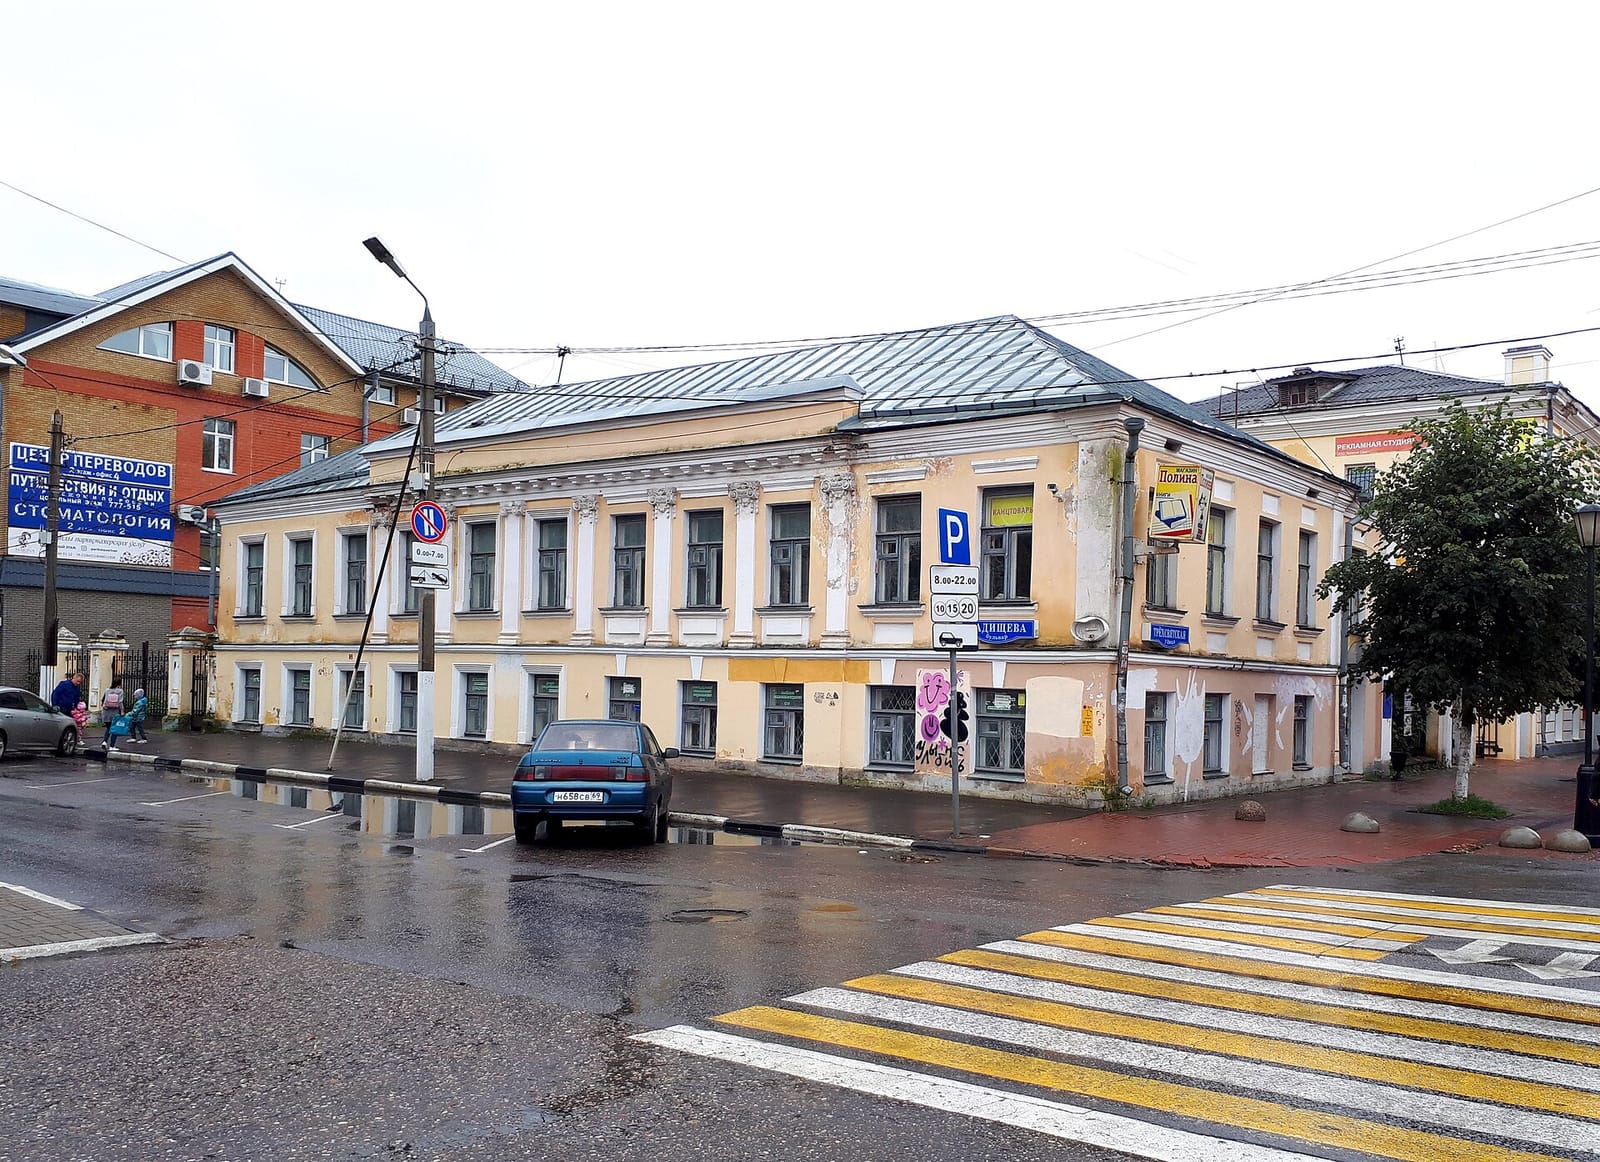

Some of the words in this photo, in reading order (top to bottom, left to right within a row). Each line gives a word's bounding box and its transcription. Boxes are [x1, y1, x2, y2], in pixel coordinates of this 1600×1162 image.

[1337, 441, 1381, 451] РЕКЛАМНАЯ
[17, 446, 70, 465] ЦЕНР
[74, 454, 167, 478] ПЕРЕВОДОВ
[113, 473, 120, 481] 4
[1160, 470, 1198, 484] Полина
[11, 473, 106, 496] ПУТЕСТВИЯ
[121, 487, 165, 502] ОТДЫХ
[14, 502, 171, 530] СТОМАТОЛОГИЯ
[119, 527, 126, 535] 2
[946, 514, 964, 559] P
[416, 548, 444, 559] 0.00-7.00
[934, 575, 977, 585] 8.00-22.00
[947, 603, 958, 614] 15
[961, 601, 974, 614] 20
[977, 623, 1027, 634] АДИЩЕВА
